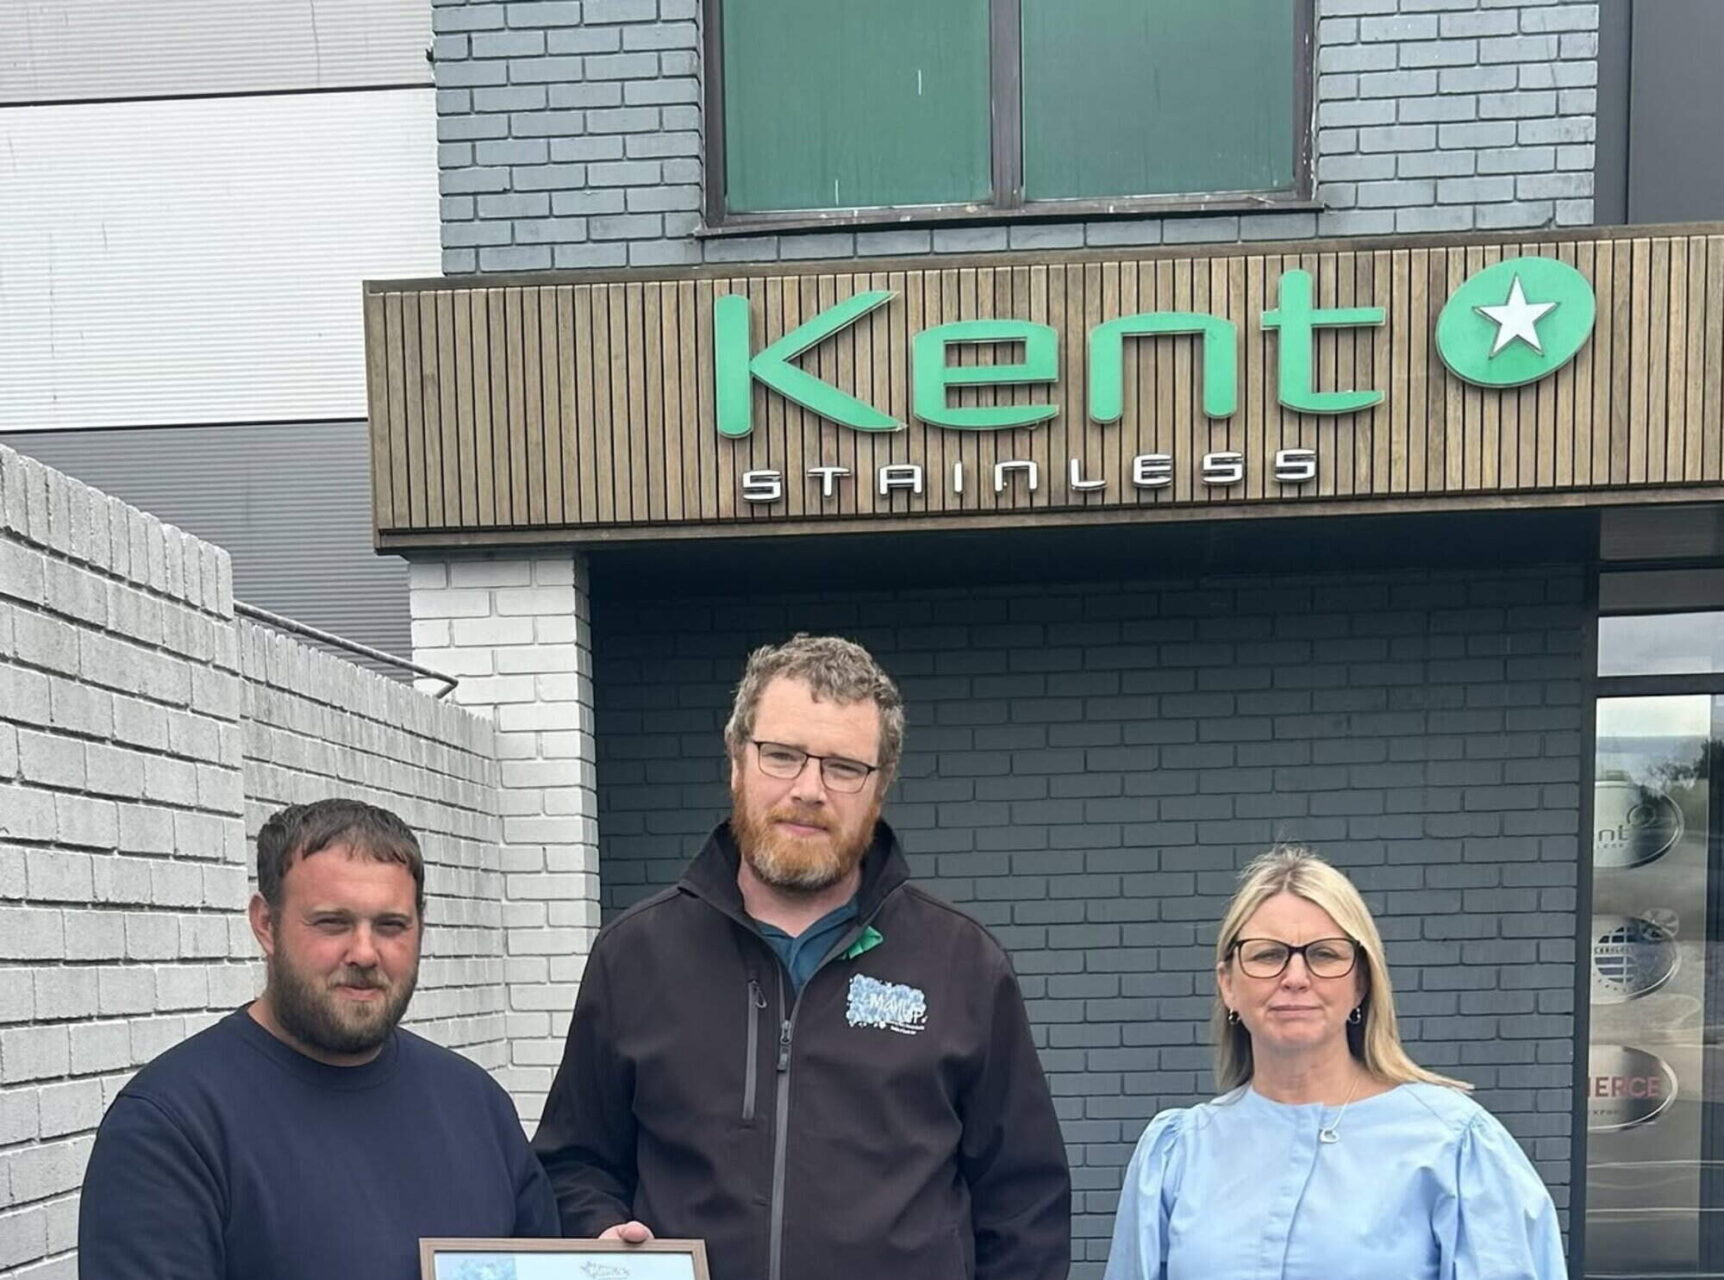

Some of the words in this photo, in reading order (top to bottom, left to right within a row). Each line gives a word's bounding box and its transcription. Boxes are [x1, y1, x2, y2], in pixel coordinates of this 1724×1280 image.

[714, 268, 1387, 440] Kent
[741, 448, 1319, 503] STAINLESS
[1588, 1076, 1660, 1097] ERCE
